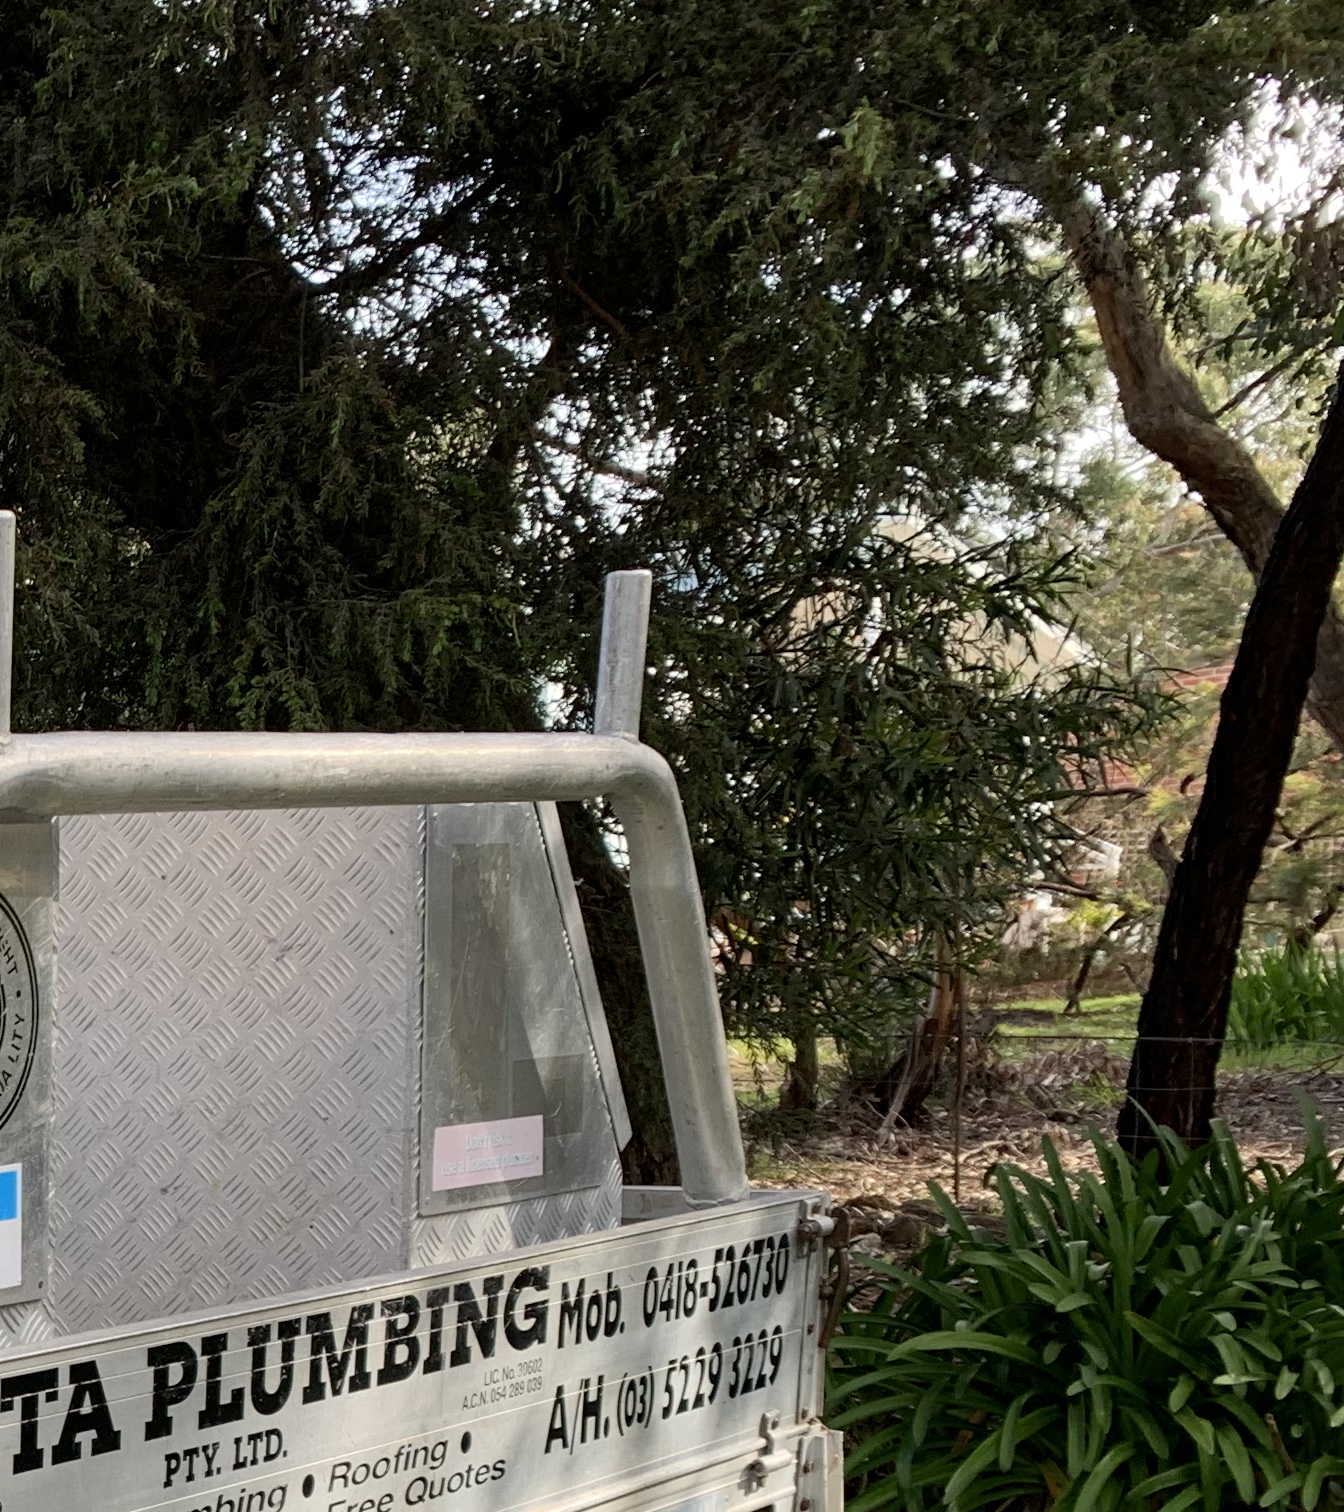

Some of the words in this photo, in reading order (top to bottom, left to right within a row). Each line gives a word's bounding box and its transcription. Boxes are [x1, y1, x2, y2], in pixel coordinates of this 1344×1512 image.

[557, 1272, 626, 1351] Mob.
[642, 1232, 791, 1329] 0418-526730
[143, 1265, 551, 1442] PLUMBING
[490, 1385, 507, 1403] 054
[508, 1380, 525, 1399] 289
[526, 1375, 543, 1394] 039
[544, 1374, 611, 1456] A/H.
[615, 1364, 654, 1438] (03)
[661, 1340, 724, 1420] 5229
[728, 1324, 784, 1400] 3229
[162, 1451, 222, 1489] PTY.
[231, 1426, 289, 1473] LTD.
[326, 1432, 449, 1494] Roofing
[404, 1457, 507, 1508] Quotes
